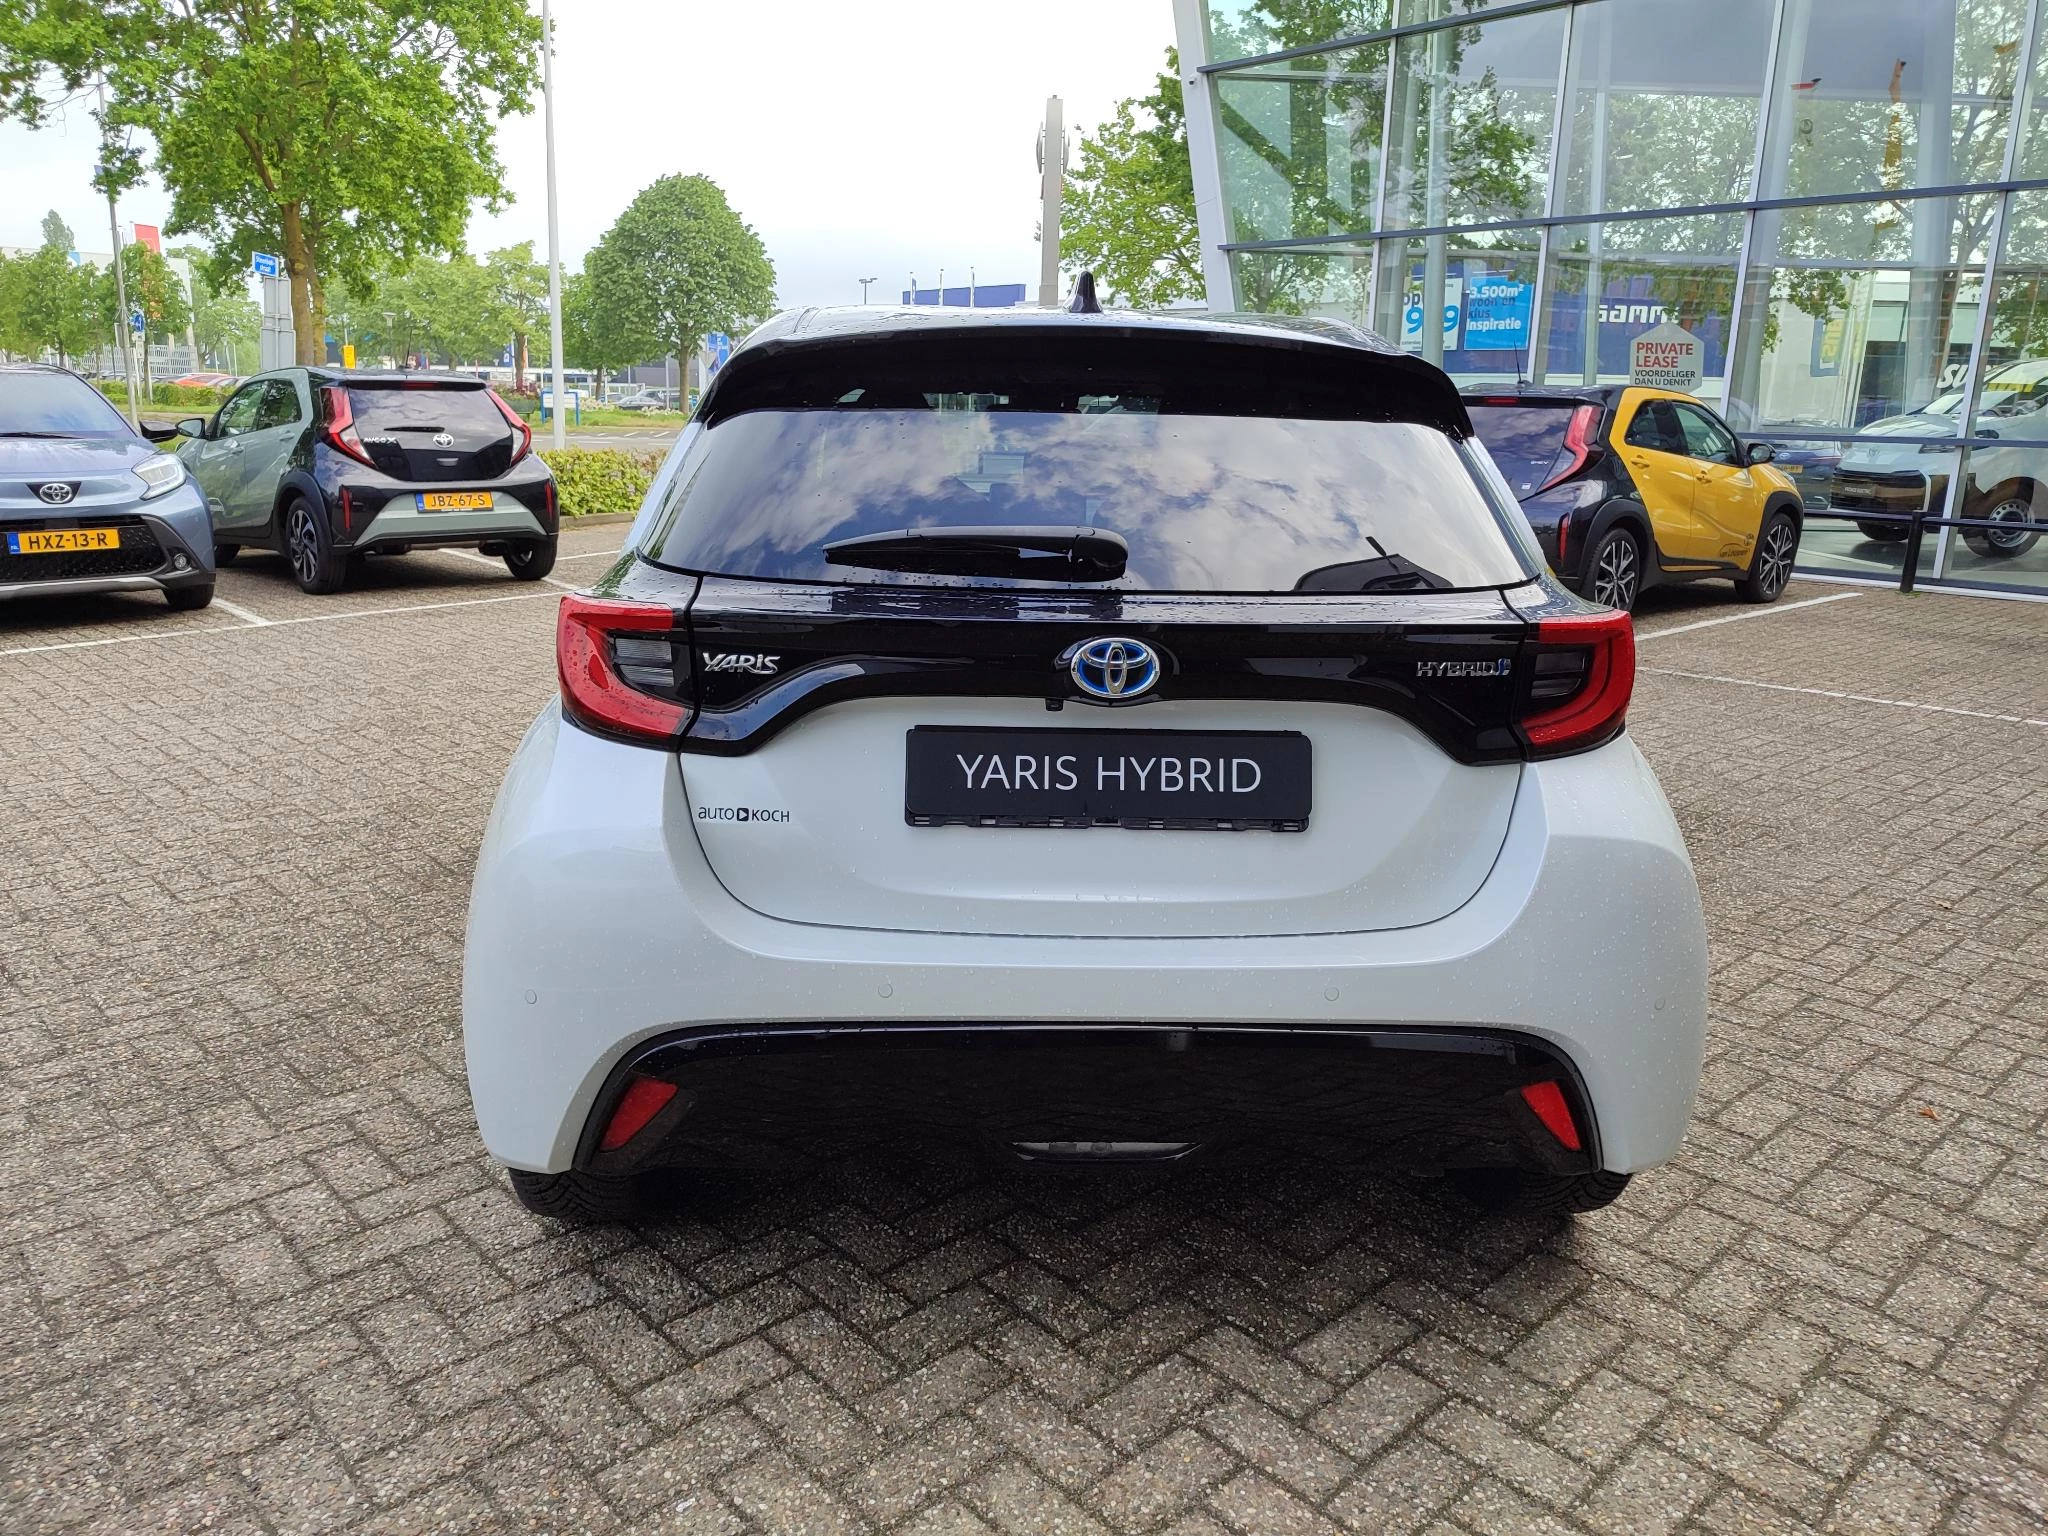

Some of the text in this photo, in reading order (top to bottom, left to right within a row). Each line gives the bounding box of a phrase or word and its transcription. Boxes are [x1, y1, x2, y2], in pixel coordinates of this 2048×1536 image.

[1636, 342, 1693, 355] PRIVATE
[1635, 355, 1678, 368] LEASE
[1634, 369, 1696, 378] VOORDELIGER
[1663, 378, 1691, 386] DENKT
[431, 494, 486, 507] JBZ-67-S
[28, 532, 108, 550] HXZ-13-R
[702, 652, 781, 675] YARIS
[1416, 661, 1500, 677] HYBRID
[956, 754, 1262, 793] YARIS HYBRID
